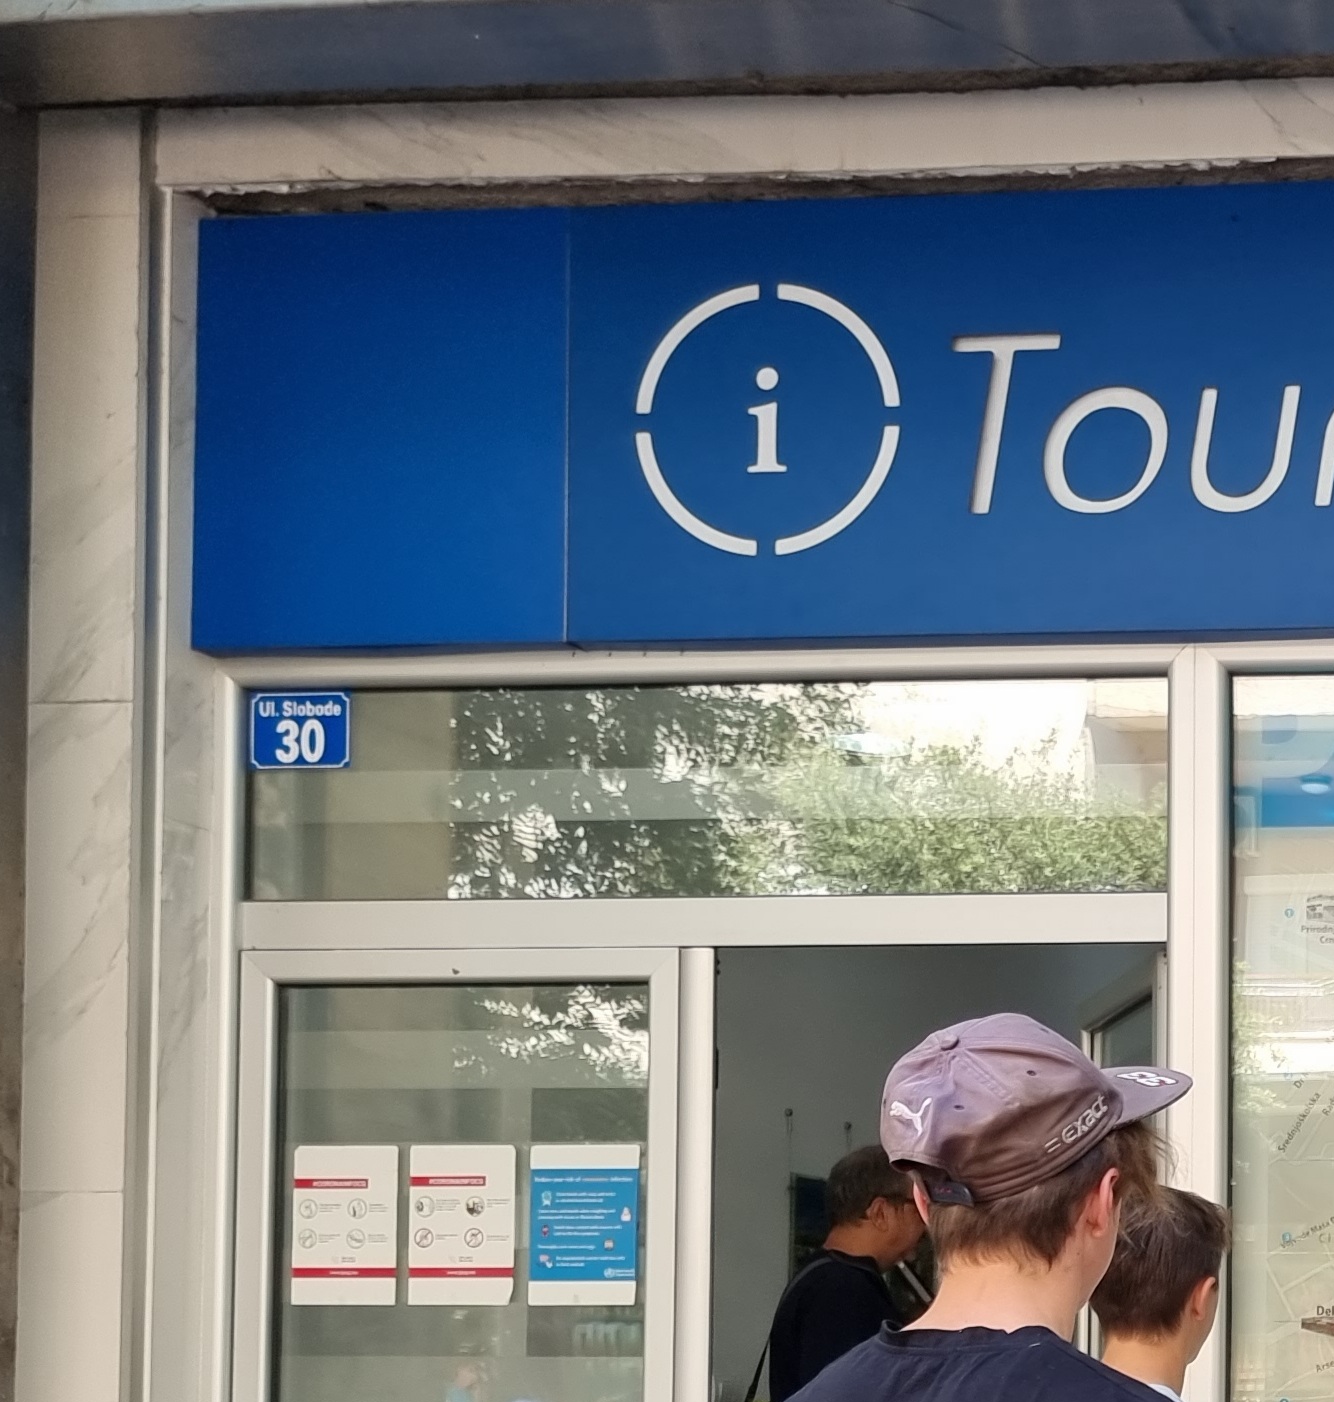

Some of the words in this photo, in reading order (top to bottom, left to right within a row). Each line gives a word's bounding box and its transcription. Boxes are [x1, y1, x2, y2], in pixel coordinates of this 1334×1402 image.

[259, 701, 279, 717] Ul.
[282, 701, 342, 717] Slobode
[275, 719, 326, 764] 30
[1062, 1094, 1109, 1144] exact
